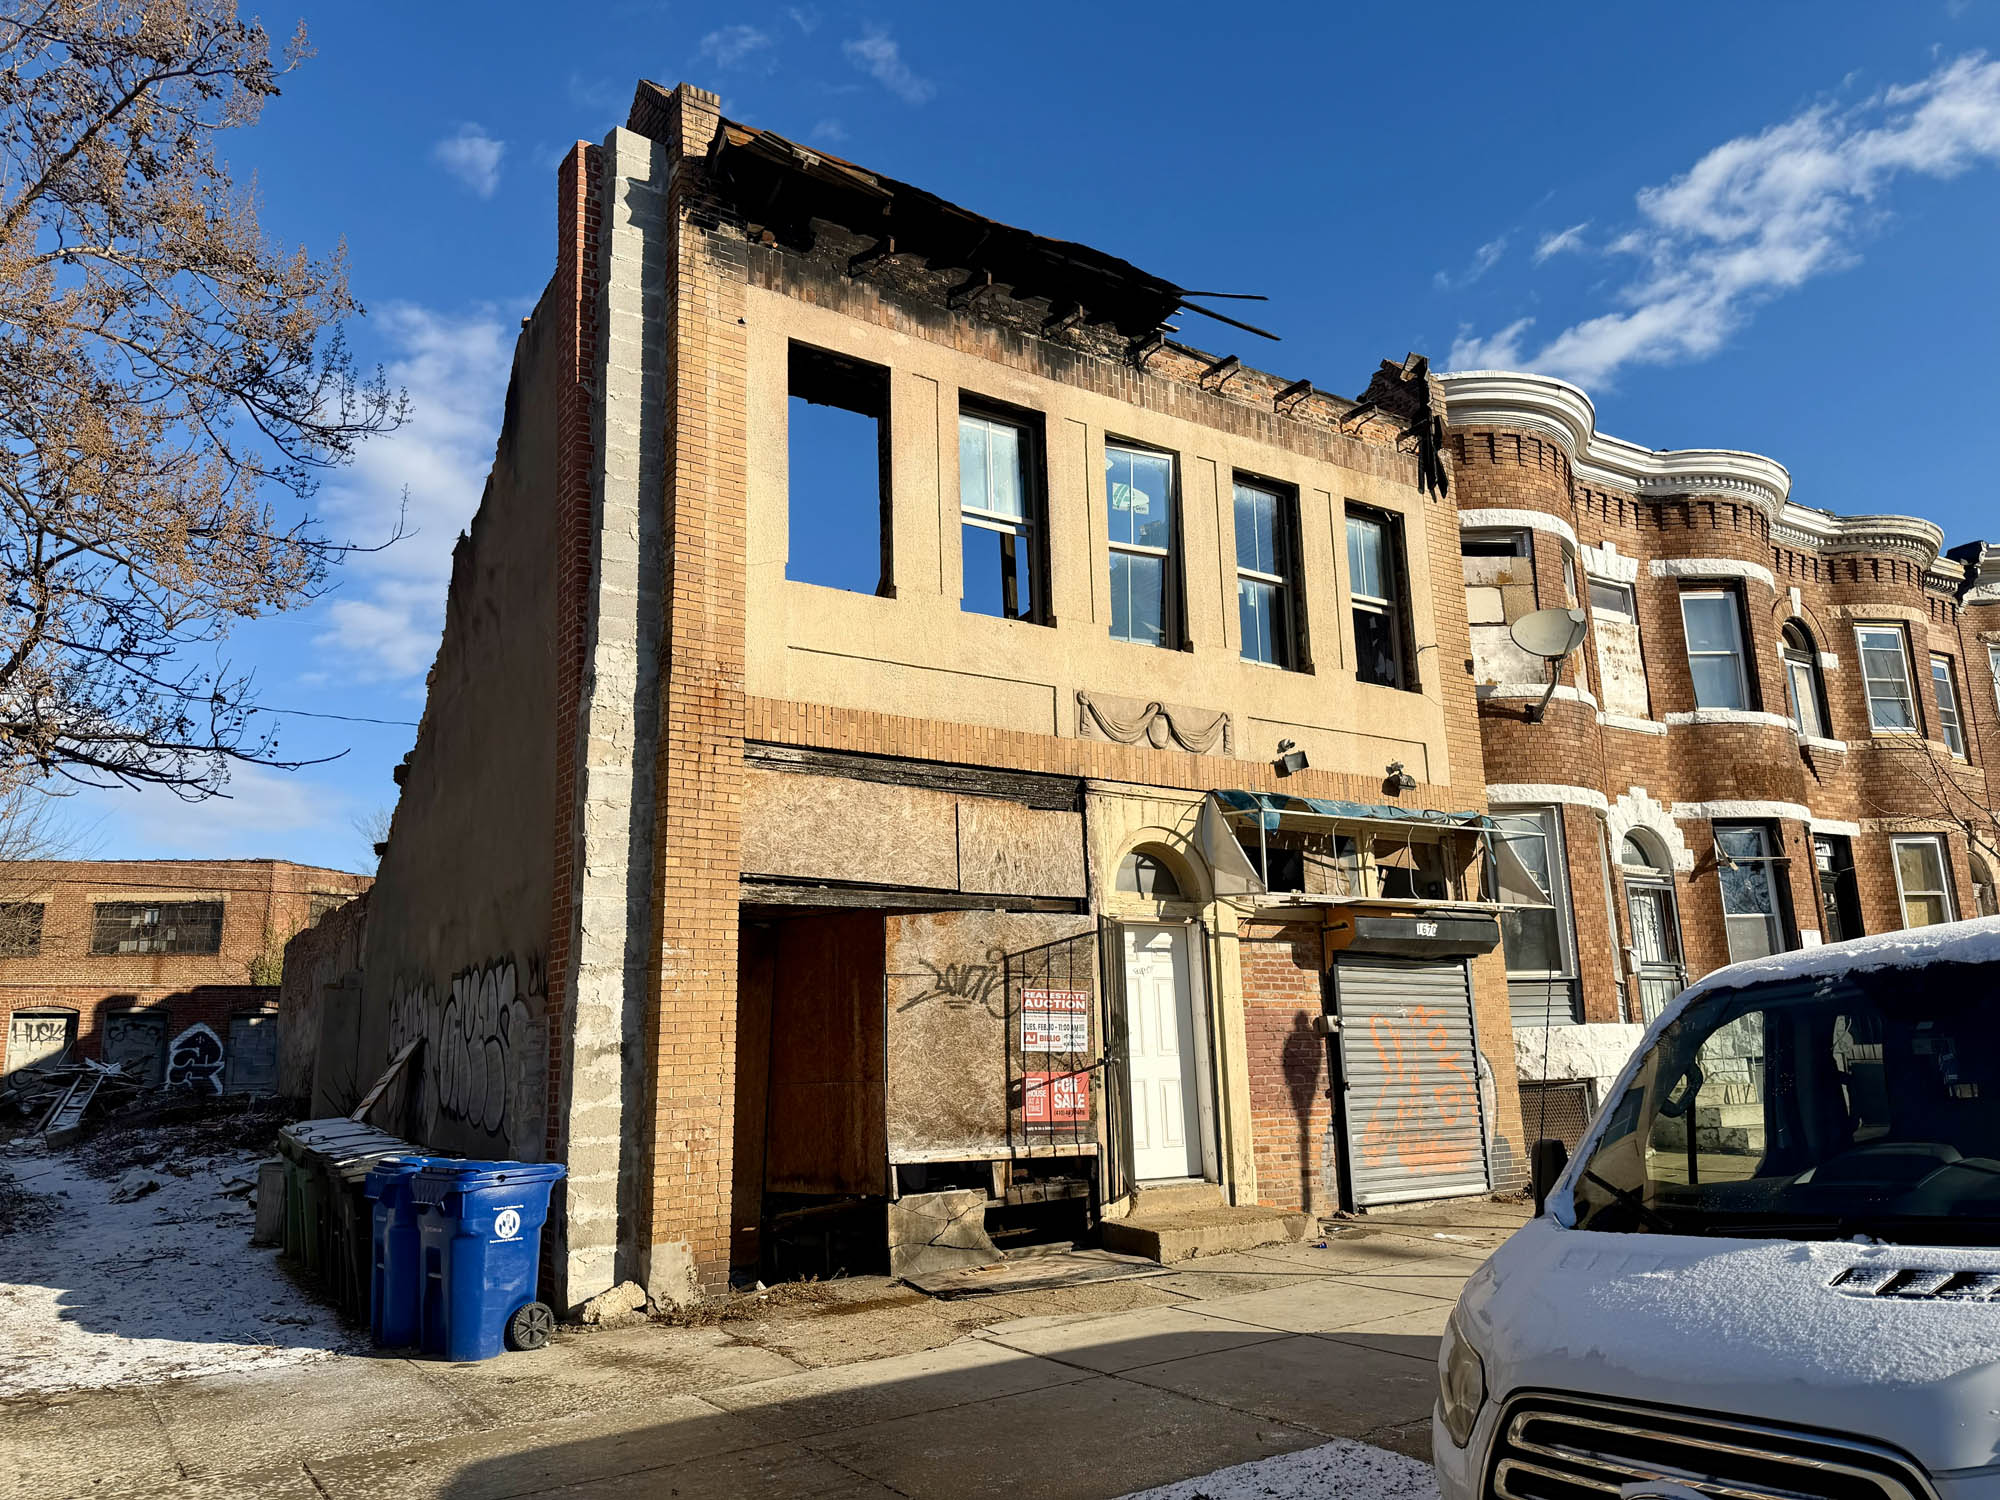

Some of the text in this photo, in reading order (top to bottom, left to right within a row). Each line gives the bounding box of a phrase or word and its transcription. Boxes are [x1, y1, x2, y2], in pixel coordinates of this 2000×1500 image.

[1024, 991, 1086, 1000] REAL ESTATE
[1024, 999, 1086, 1009] AUCTION
[1054, 1076, 1078, 1093] FOR
[1054, 1093, 1086, 1109] SALE
